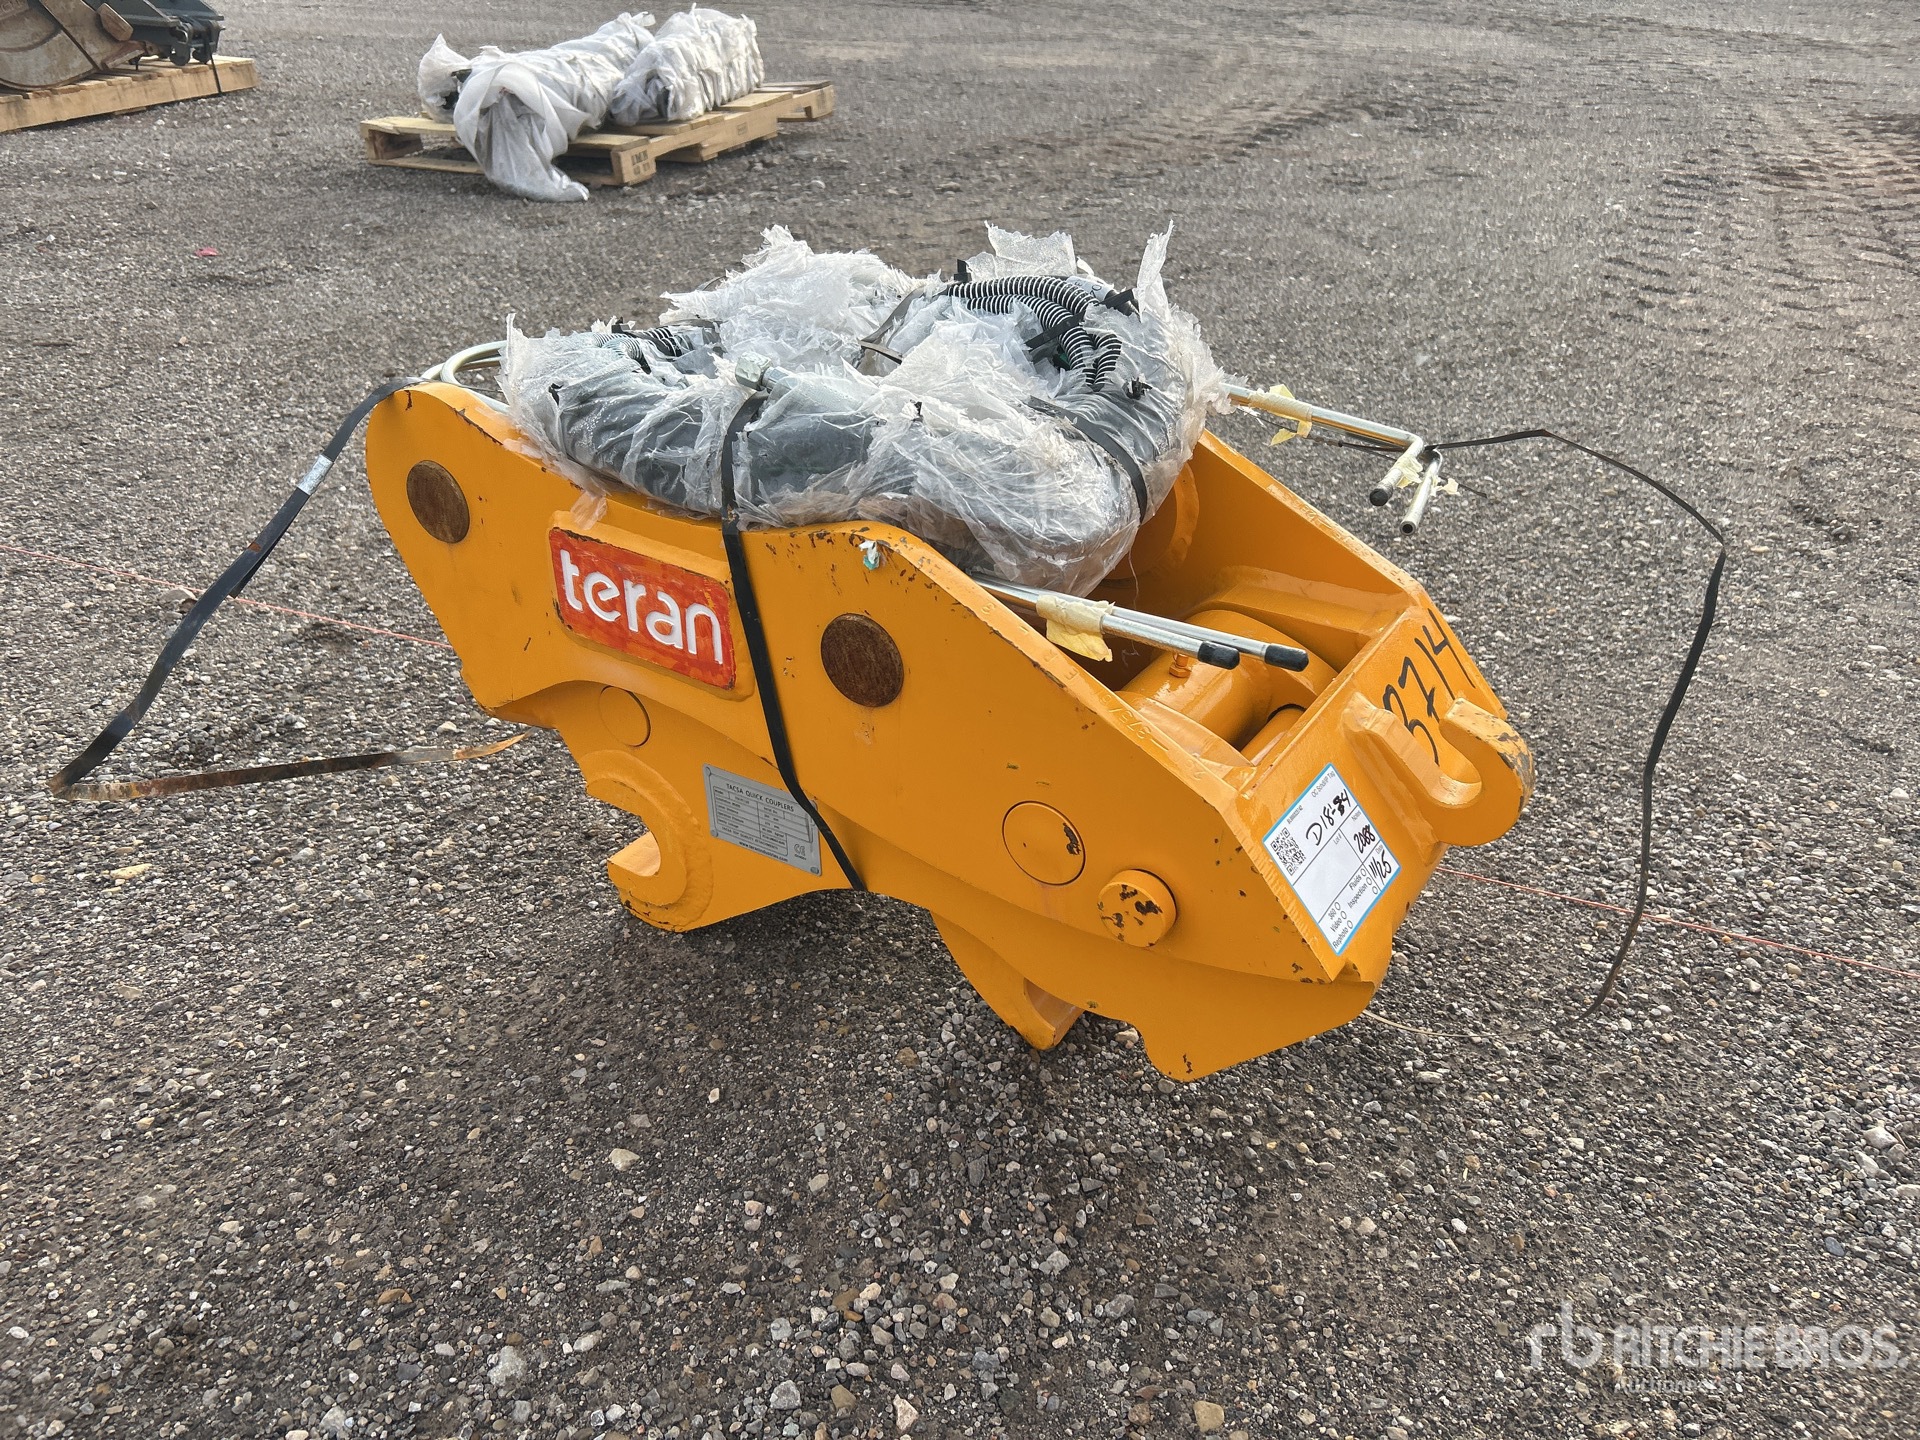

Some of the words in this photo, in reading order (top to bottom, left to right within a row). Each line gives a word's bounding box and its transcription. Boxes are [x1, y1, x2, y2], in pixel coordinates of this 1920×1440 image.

[560, 549, 724, 666] teran
[726, 783, 744, 795] TACSA
[745, 790, 764, 802] QUICK
[765, 797, 795, 813] COUPLERS
[1348, 874, 1362, 890] Fluids
[1347, 883, 1368, 909] Inspection
[1330, 917, 1342, 932] Video
[1332, 927, 1349, 949] Rephoto
